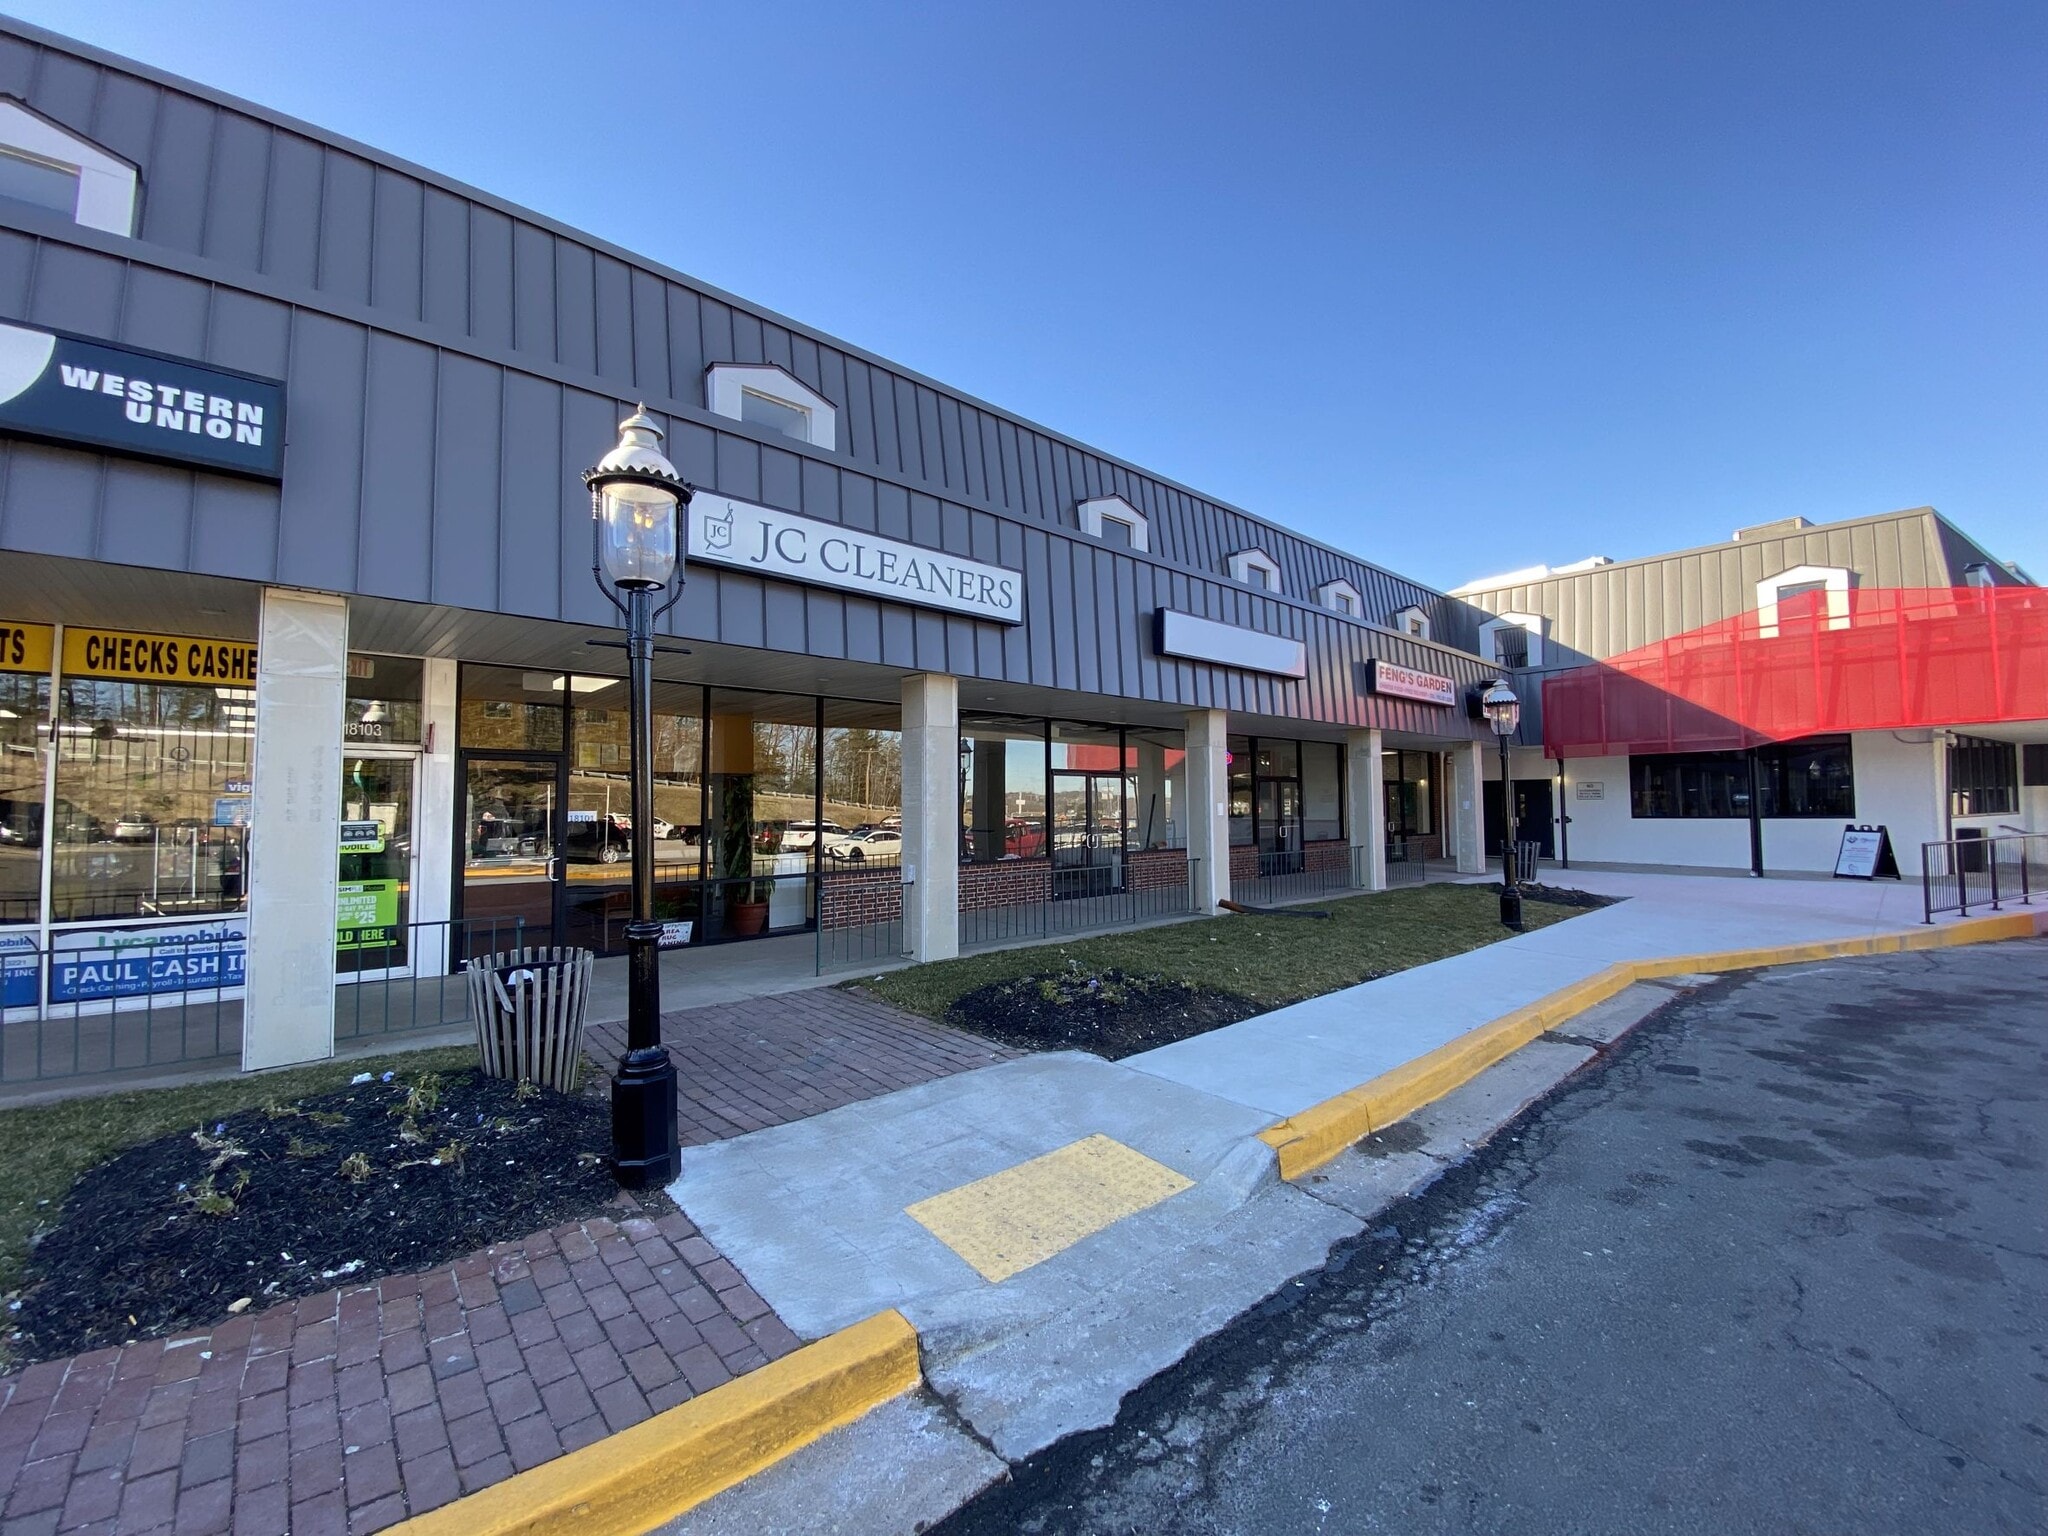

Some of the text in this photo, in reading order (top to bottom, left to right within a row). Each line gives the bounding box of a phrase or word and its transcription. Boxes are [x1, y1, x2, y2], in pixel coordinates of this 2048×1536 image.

[60, 365, 263, 426] WESTERN
[125, 400, 262, 446] UNION
[710, 524, 727, 538] JC
[750, 520, 1013, 609] JC CLEANERS
[86, 635, 258, 680] CHECKS CASHE
[347, 659, 369, 677] XIT
[1379, 666, 1414, 685] FENG'S
[1416, 675, 1452, 693] GARDEN
[344, 722, 382, 737] 18103
[228, 782, 252, 793] vig
[64, 963, 139, 985] PAUL
[147, 956, 219, 978] CASH
[141, 978, 173, 989] Pyroll
[177, 974, 221, 985] Insuranc
